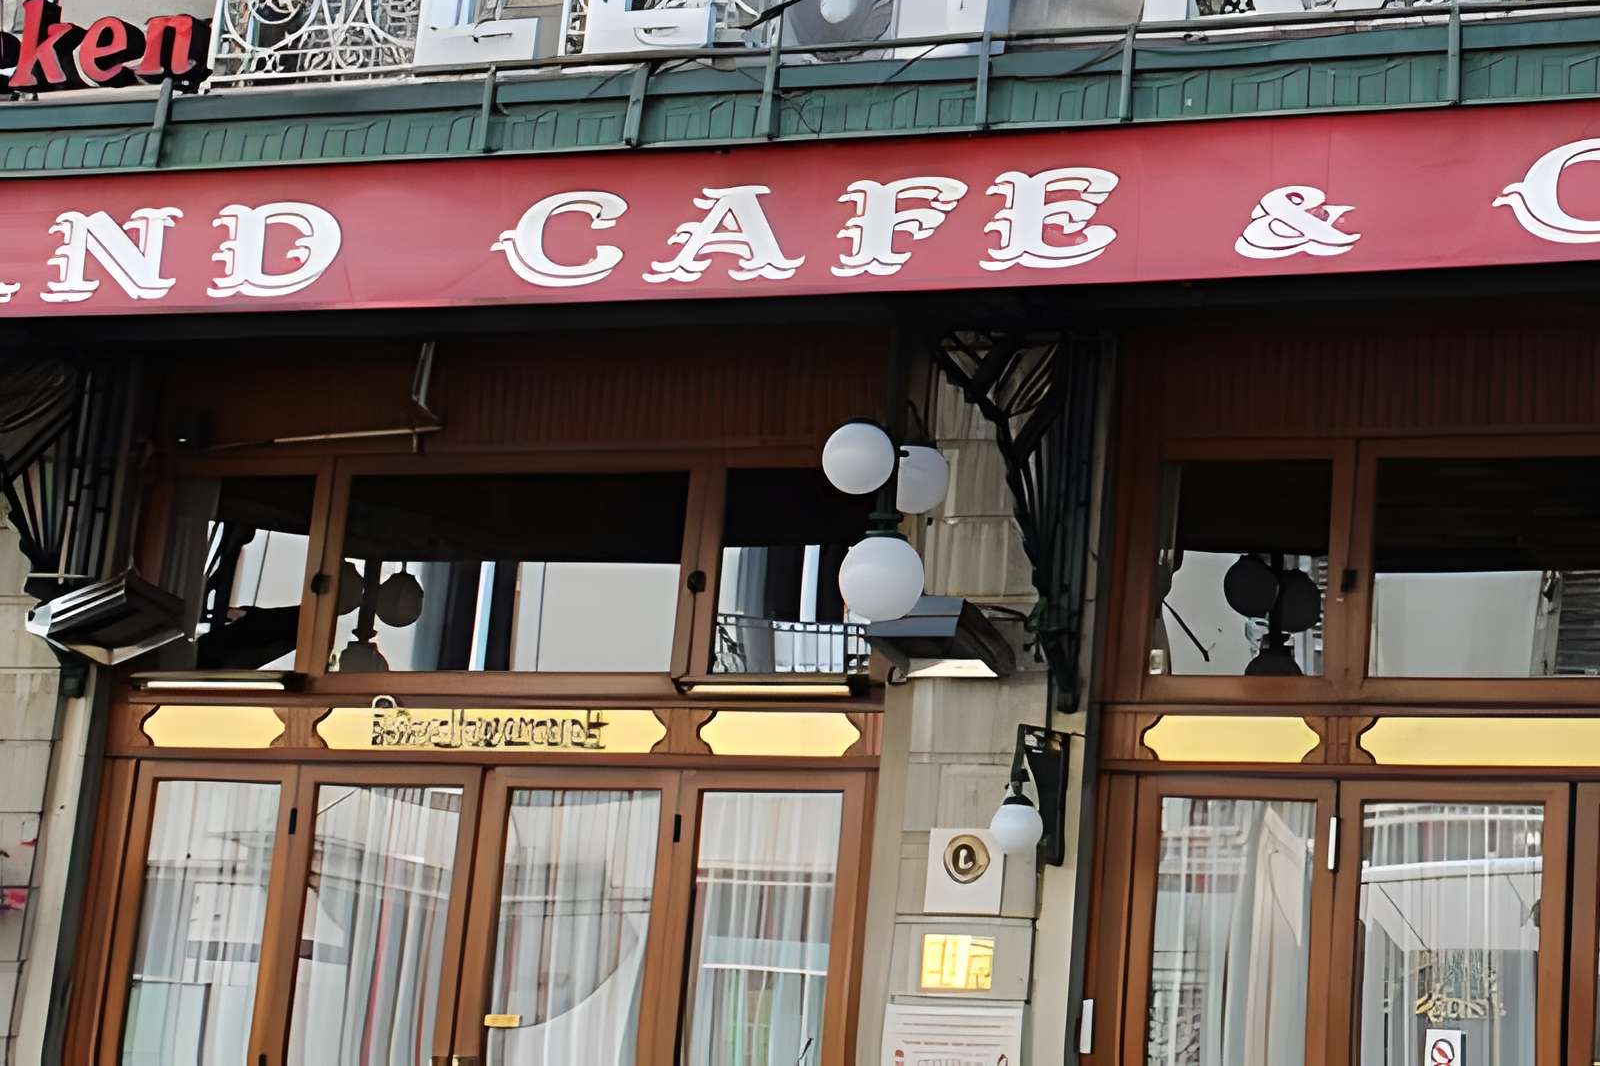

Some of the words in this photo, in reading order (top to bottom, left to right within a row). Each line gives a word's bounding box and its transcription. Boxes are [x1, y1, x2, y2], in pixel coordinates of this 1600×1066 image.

[0, 201, 343, 302] ND
[490, 166, 1119, 288] CAFE
[1233, 185, 1362, 260] &
